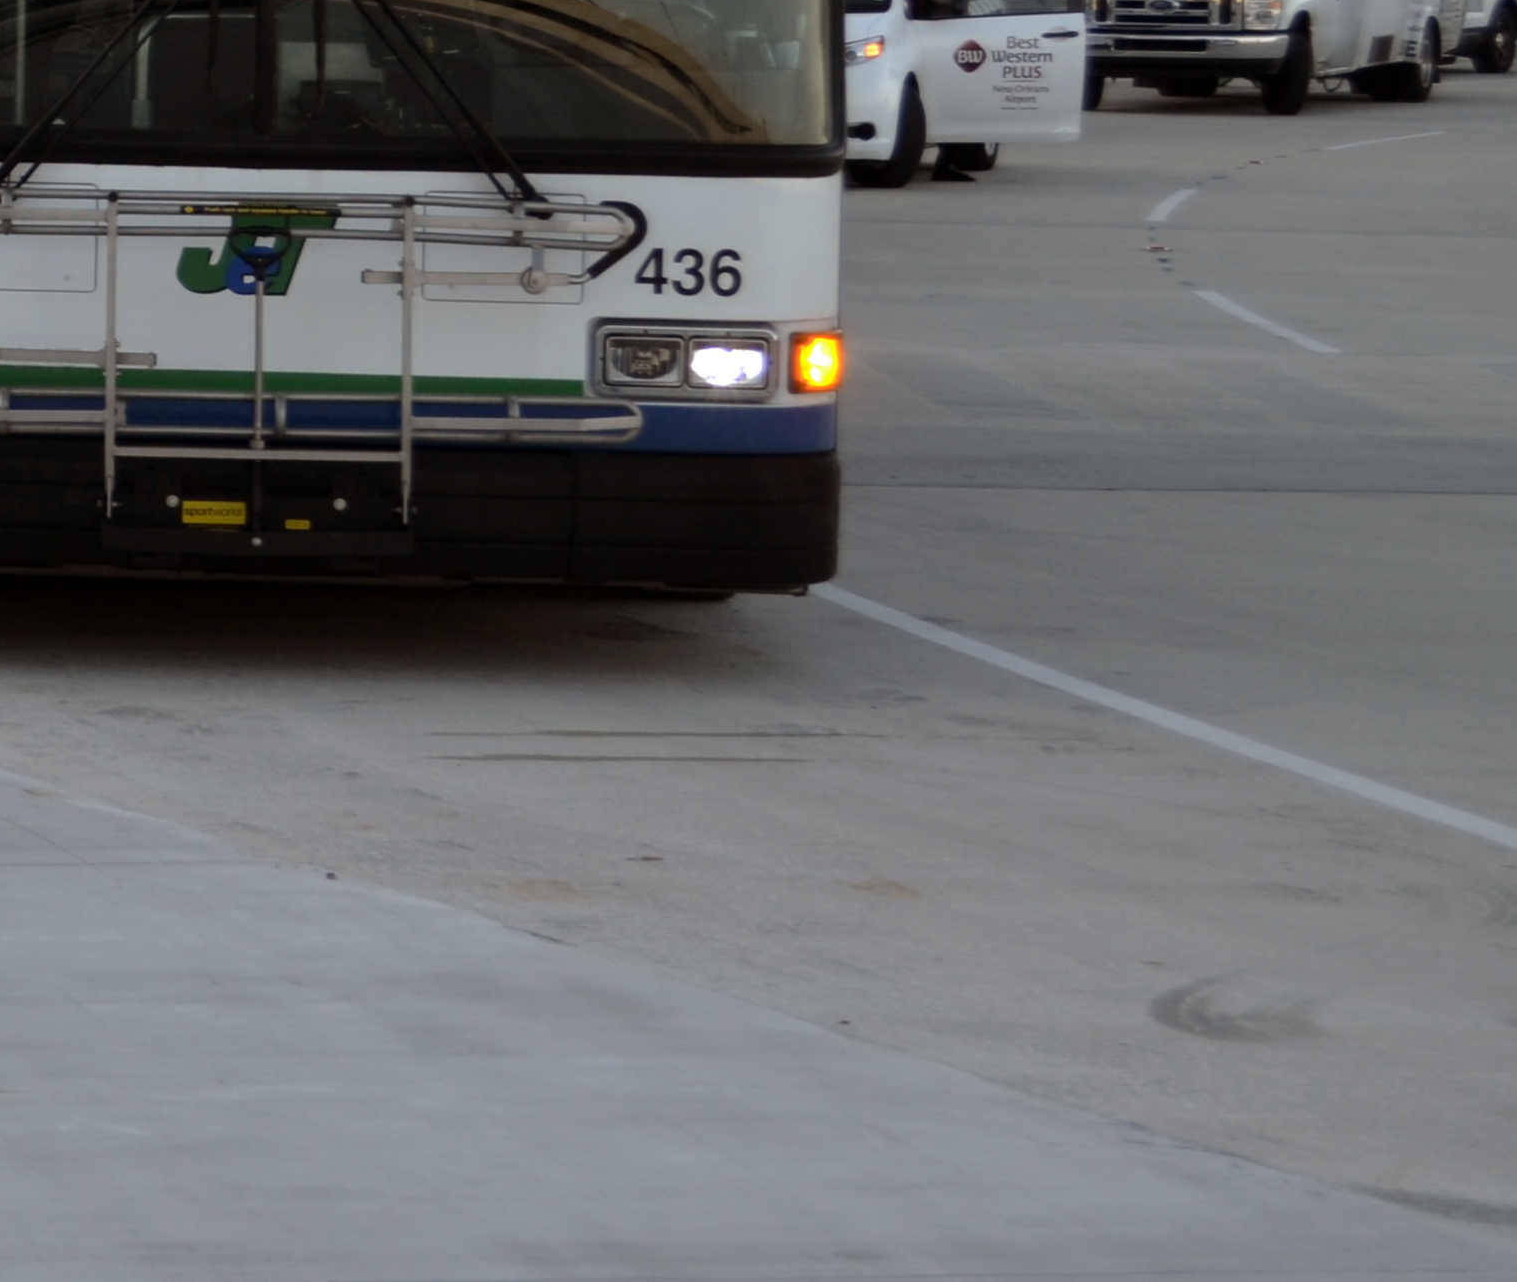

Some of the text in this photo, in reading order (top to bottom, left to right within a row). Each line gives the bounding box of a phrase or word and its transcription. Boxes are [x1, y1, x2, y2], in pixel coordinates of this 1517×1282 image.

[1006, 36, 1040, 49] Best
[957, 49, 983, 64] BW
[991, 50, 1053, 63] Western
[1002, 65, 1042, 79] PLUS
[993, 84, 1049, 93] New Orleans
[1004, 95, 1037, 104] Airport
[634, 247, 742, 297] 436
[183, 506, 243, 517] sportworks
